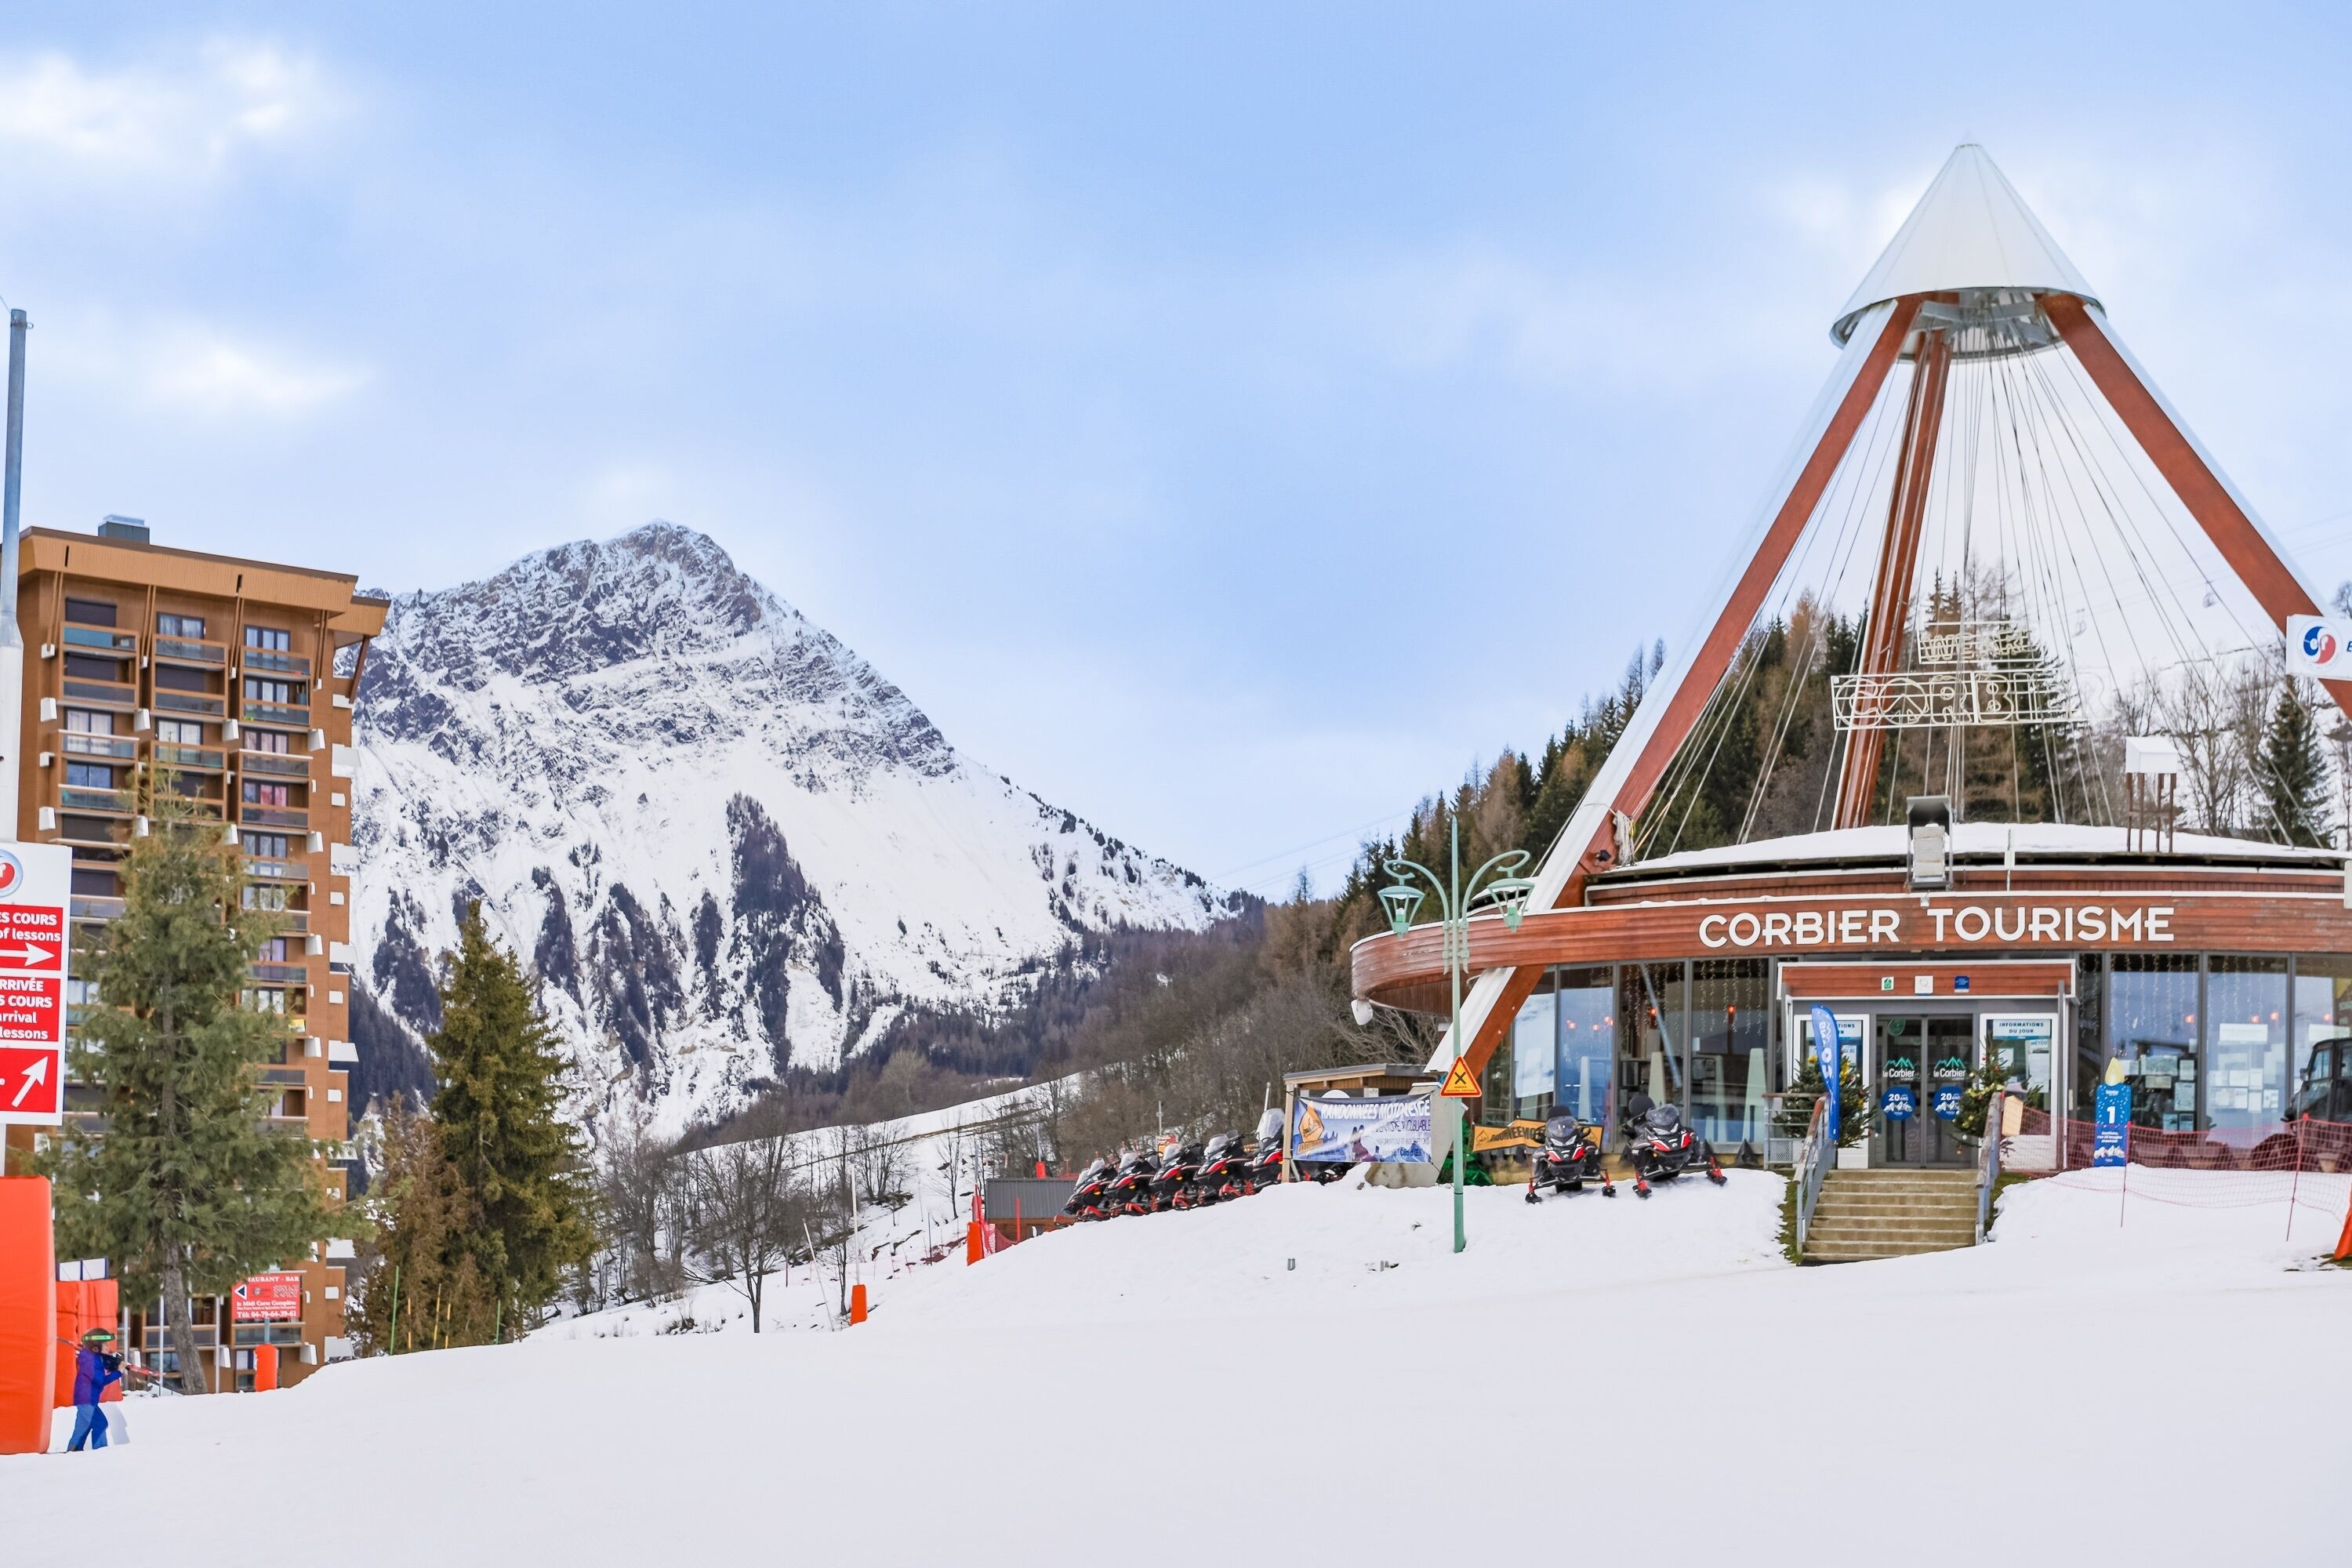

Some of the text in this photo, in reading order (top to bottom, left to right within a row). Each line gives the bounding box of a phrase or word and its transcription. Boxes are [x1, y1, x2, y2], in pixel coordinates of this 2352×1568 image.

[12, 912, 58, 926] COURS
[1698, 906, 2175, 948] CORBIER TOURISME
[12, 928, 62, 942] lessons
[0, 978, 45, 993] RRIVÉE
[7, 995, 53, 1008] COURS
[1882, 1068, 1915, 1078] le Corbier
[1933, 1068, 1966, 1078] le Corbier
[1319, 1103, 1378, 1120] RANDONNEES
[2107, 1105, 2116, 1124] 1
